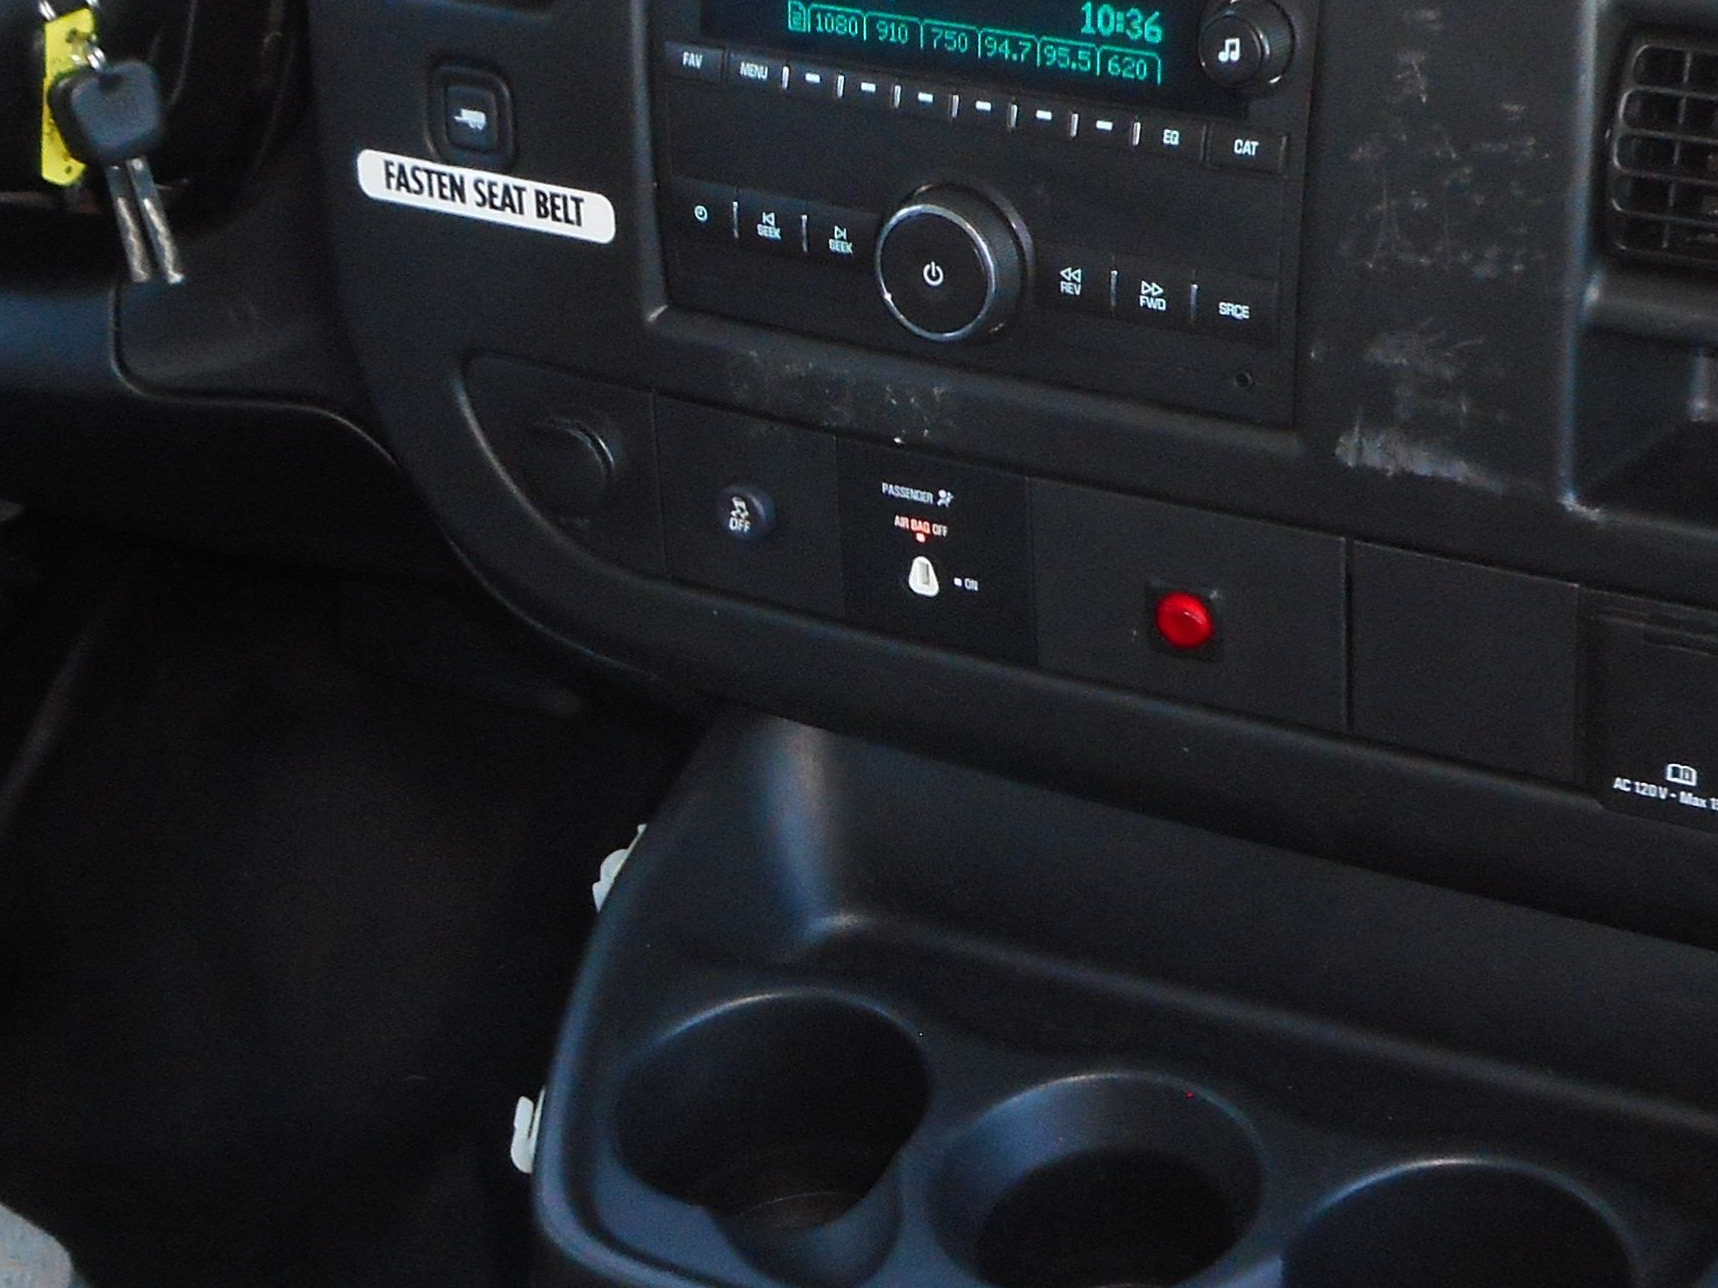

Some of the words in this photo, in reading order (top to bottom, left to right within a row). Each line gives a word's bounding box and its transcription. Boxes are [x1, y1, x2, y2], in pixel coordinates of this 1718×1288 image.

[1081, 1, 1163, 44] 10:36
[815, 12, 859, 38] 1080
[875, 20, 910, 45] 910
[930, 27, 969, 53] 750
[984, 36, 1032, 63] 94.7
[1043, 44, 1091, 72] 95.5
[1106, 54, 1148, 81] 620
[682, 51, 703, 70] FAV
[740, 61, 769, 81] MENU
[1163, 128, 1180, 146] EQ
[1233, 138, 1260, 157] CAT
[384, 159, 467, 205] FASTEN
[473, 175, 527, 216] SEAT
[535, 189, 585, 228] BELT
[756, 223, 782, 241] SEEK
[828, 238, 854, 255] SEEK
[1059, 280, 1082, 297] REV
[1139, 295, 1167, 312] FWD
[1218, 301, 1251, 321] SRCE
[882, 481, 934, 505] PASSENGER
[729, 516, 751, 533] OFF
[894, 514, 910, 530] AIR
[910, 518, 931, 535] BAG
[931, 522, 948, 537] OFF
[964, 577, 979, 591] ON
[1612, 776, 1632, 793] AC
[1679, 789, 1707, 809] Max
